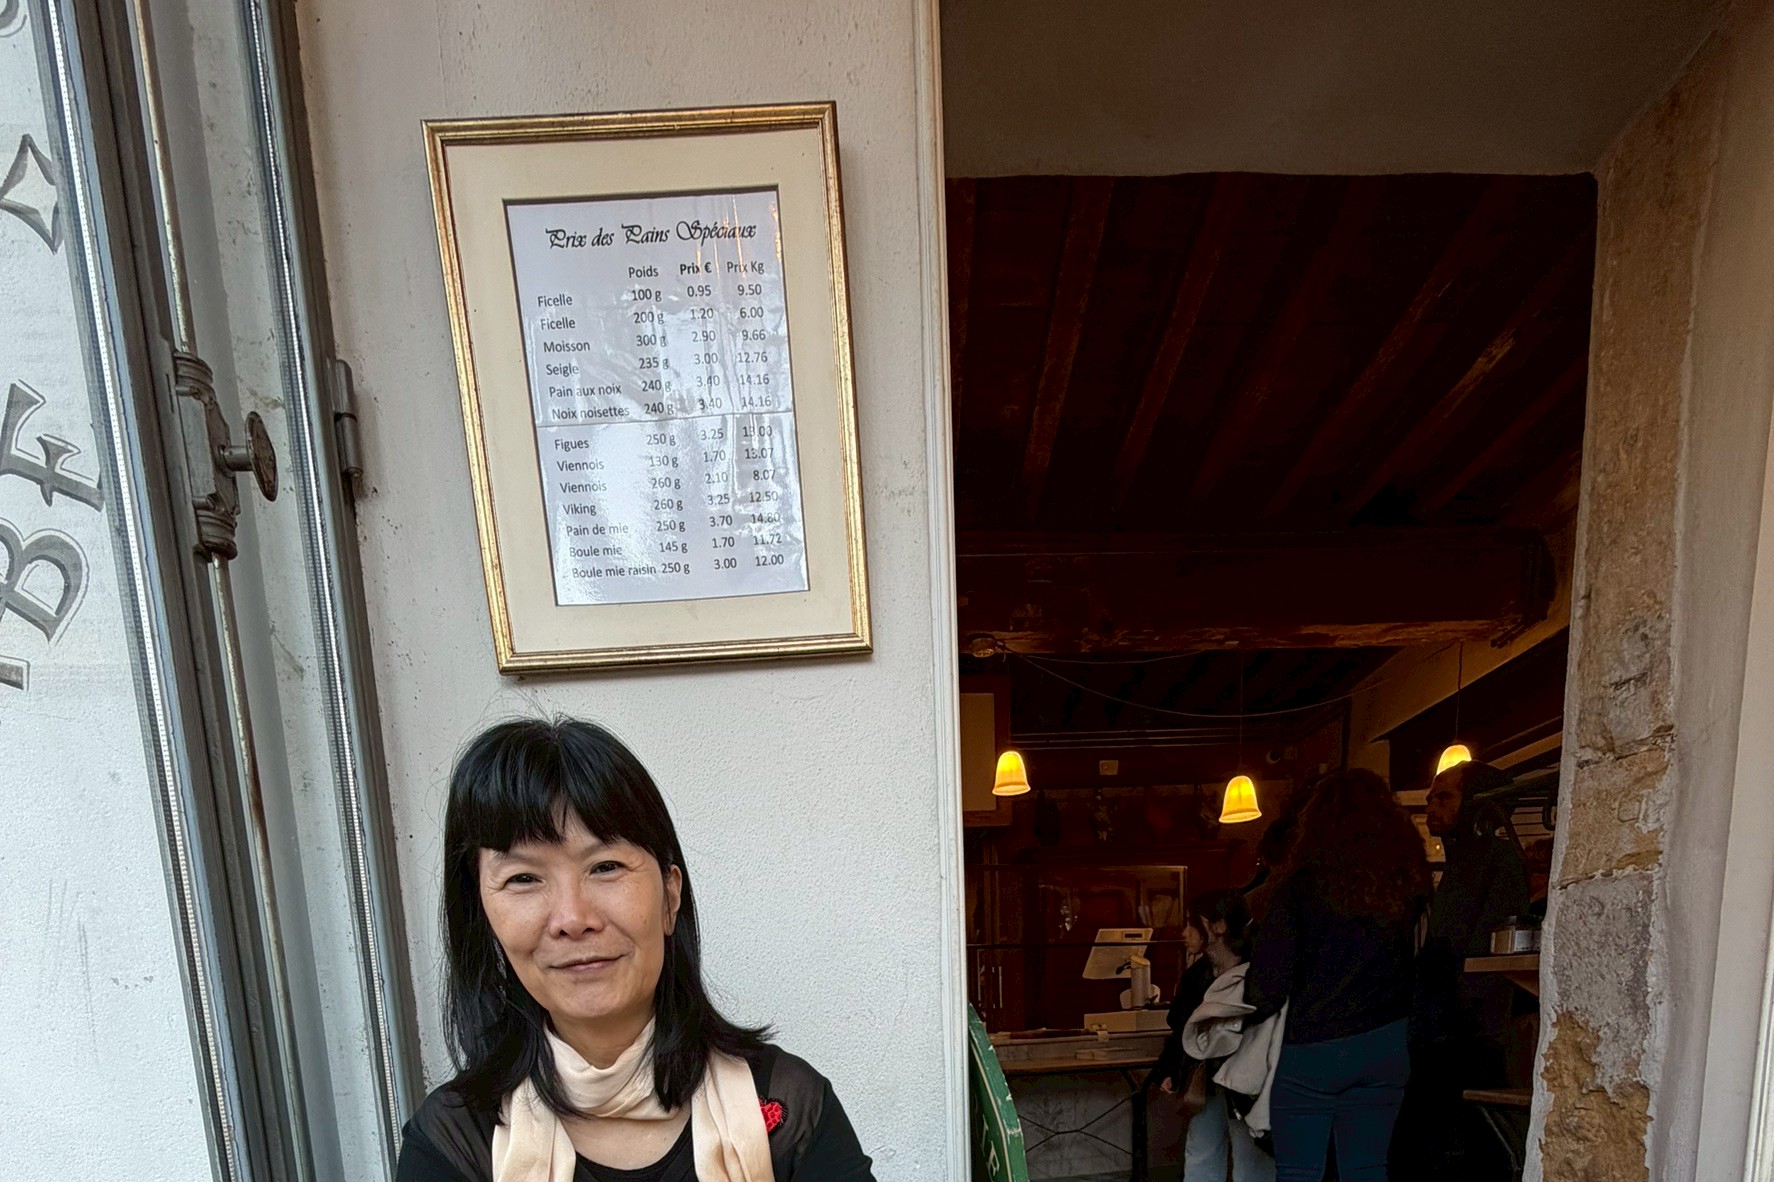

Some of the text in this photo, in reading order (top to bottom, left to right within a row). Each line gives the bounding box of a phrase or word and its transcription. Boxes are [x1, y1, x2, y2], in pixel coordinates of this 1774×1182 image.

[545, 228, 586, 248] Prix
[591, 228, 615, 247] des
[621, 224, 670, 245] Pains
[628, 266, 659, 279] Poids
[680, 262, 712, 275] Prix €
[727, 261, 765, 275] Prix Kg
[631, 289, 652, 301] 100
[687, 285, 712, 297] 0.95
[737, 284, 762, 296] 9.50
[537, 295, 573, 307] Ficelle
[633, 312, 655, 324] 200
[690, 308, 714, 320] 1.20
[739, 306, 764, 319] 6.00
[540, 317, 576, 330] Ficelle
[636, 335, 657, 347] 300
[692, 330, 716, 342] 2.90
[742, 330, 766, 341] 9.66
[543, 340, 590, 353] Moisson
[638, 357, 660, 369] 235
[694, 353, 719, 365] 3.00
[738, 352, 768, 363] 12.76
[546, 363, 579, 378] Seigle
[696, 375, 720, 387] 3.40
[740, 374, 770, 385] 14.16
[549, 384, 622, 398] Pain aux noix
[641, 380, 662, 392] 240
[644, 402, 665, 415] 240
[699, 397, 723, 410] 3.40
[552, 406, 630, 420] Noix noisettes
[646, 434, 667, 446] 250
[700, 428, 724, 440] 3.25
[554, 438, 590, 452] Figues
[649, 456, 669, 468] 130
[703, 450, 726, 463] 1.70
[556, 460, 604, 472] Viennois
[705, 472, 728, 485] 2.10
[753, 469, 776, 481] 8.07
[559, 481, 607, 494] Viennois
[651, 477, 672, 489] 260
[707, 493, 730, 506] 3.25
[749, 491, 778, 502] 12.50
[562, 504, 597, 517] Viking
[654, 499, 674, 511] 260
[656, 520, 677, 532] 250
[709, 515, 733, 527] 3.70
[566, 523, 629, 537] Pain de mie
[712, 537, 735, 549] 1.70
[752, 533, 782, 545] 11.72
[569, 545, 623, 558] Boule mie
[659, 541, 679, 553] 145
[714, 558, 737, 570] 3.00
[755, 554, 784, 567] 12.00
[572, 564, 657, 579] Boule mie raisin
[661, 562, 682, 574] 250
